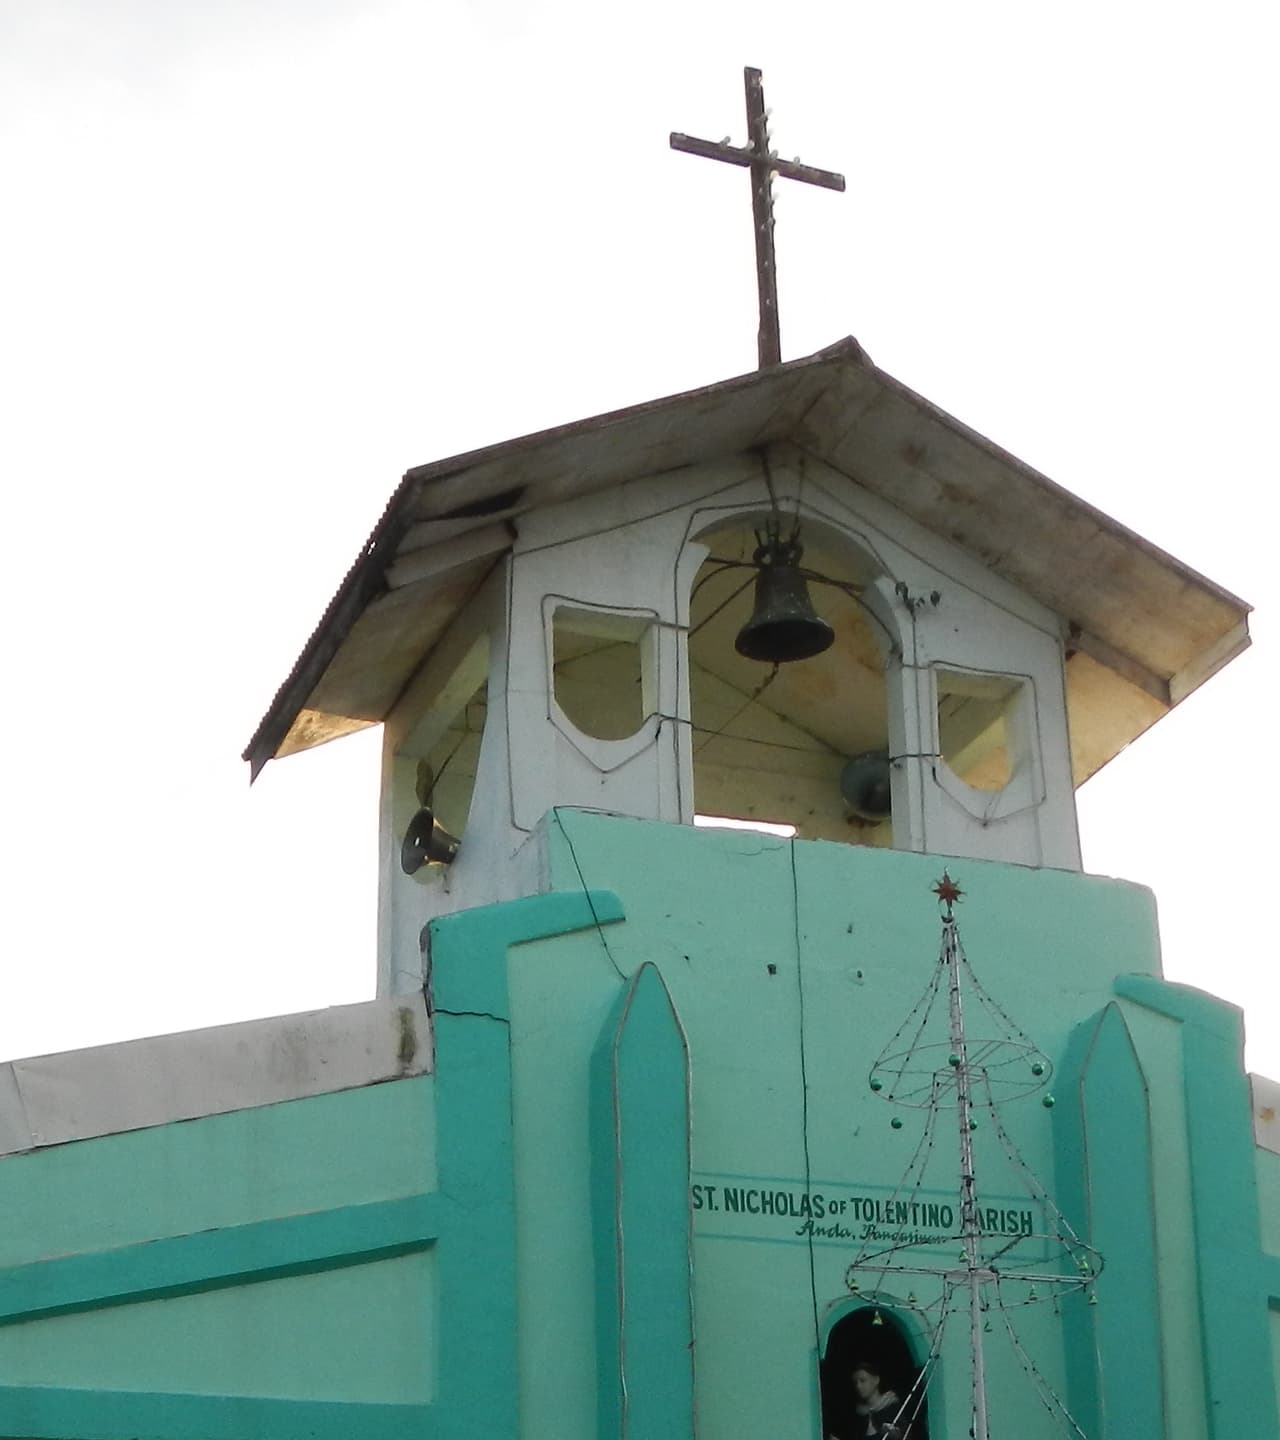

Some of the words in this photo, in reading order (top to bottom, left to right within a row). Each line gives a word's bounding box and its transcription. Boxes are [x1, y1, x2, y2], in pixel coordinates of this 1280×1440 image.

[692, 1184, 719, 1211] ST.
[724, 1187, 825, 1219] NICHOLAS
[829, 1200, 847, 1215] OF
[850, 1197, 954, 1229] TOLENTINO
[962, 1205, 1033, 1236] ARISH
[795, 1219, 856, 1241] Anda,
